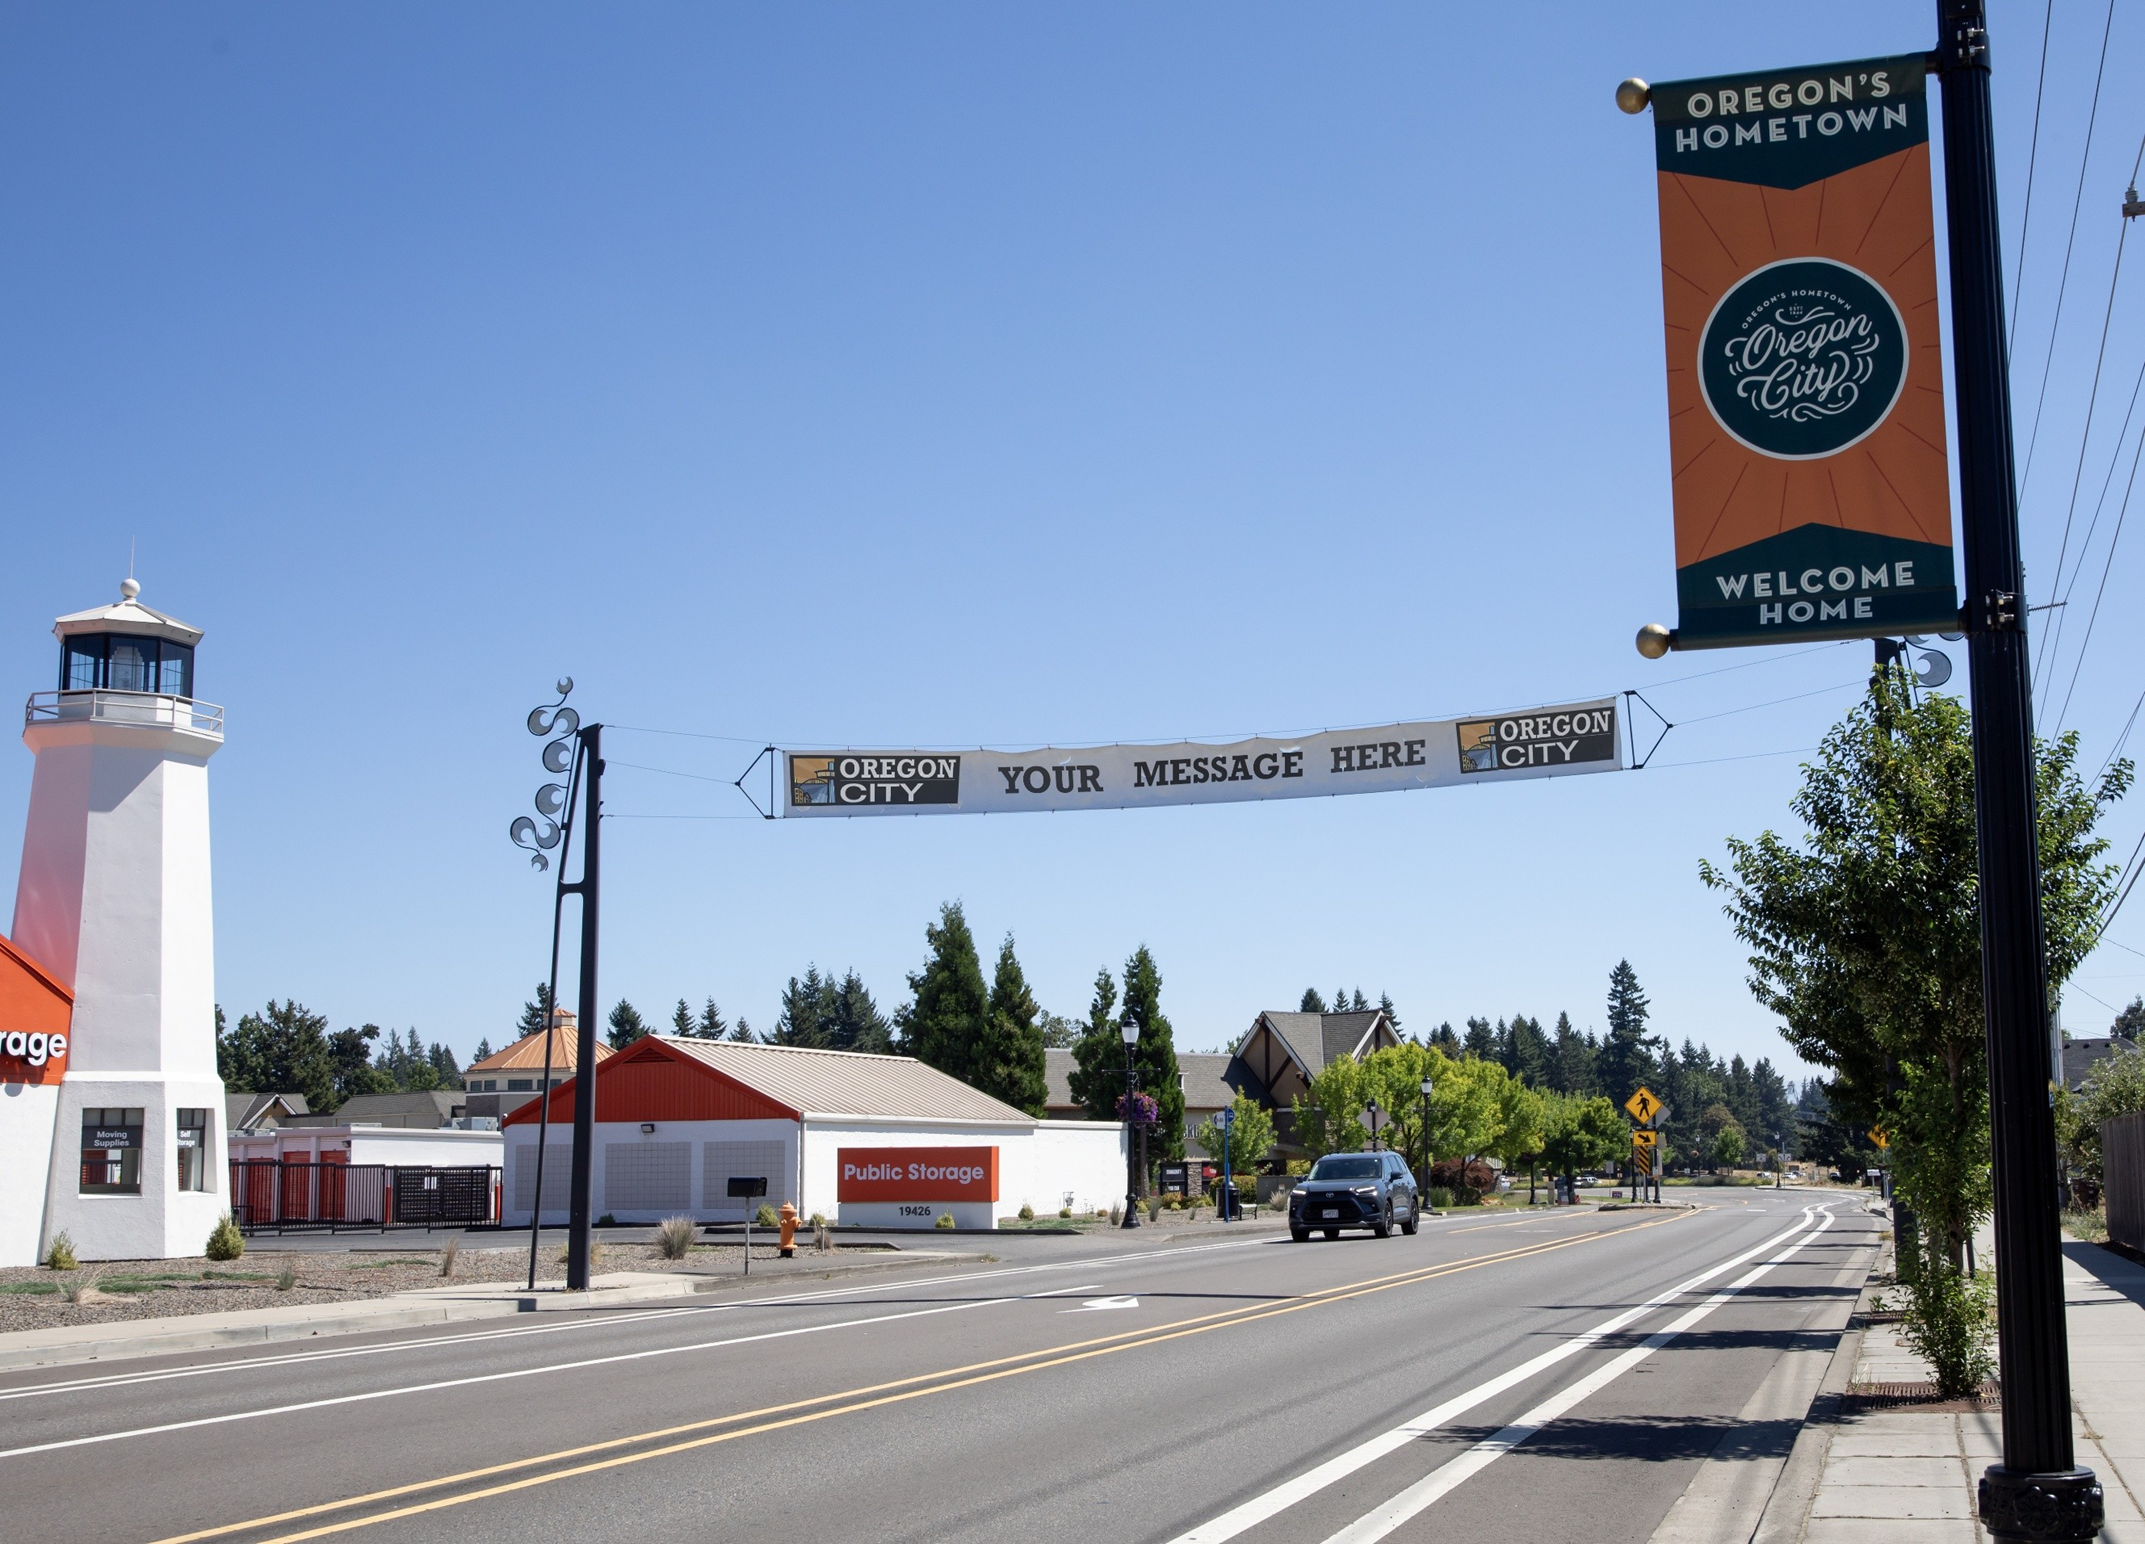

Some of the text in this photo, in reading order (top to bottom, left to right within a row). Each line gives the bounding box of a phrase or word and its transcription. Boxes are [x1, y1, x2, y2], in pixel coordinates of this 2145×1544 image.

[1687, 71, 1891, 118] OREGON'S
[1675, 103, 1908, 153] HOMETOWN
[1742, 289, 1852, 330] OREGON'S HOMETOWN
[1741, 313, 1873, 370] Oregon
[1737, 350, 1851, 410] City
[1715, 560, 1916, 600] WELCOME
[1759, 596, 1874, 625] HOME
[1499, 710, 1612, 742] OREGON
[997, 739, 1426, 794] YOUR MESSAGE HERE
[1501, 739, 1580, 767] CITY
[839, 757, 957, 779] OREGON
[839, 782, 924, 803] CITY
[93, 1139, 130, 1148] Supplies
[96, 1130, 128, 1140] Moving
[180, 1130, 191, 1138] Self
[844, 1163, 985, 1185] Public Storage
[898, 1206, 931, 1216] 19426
